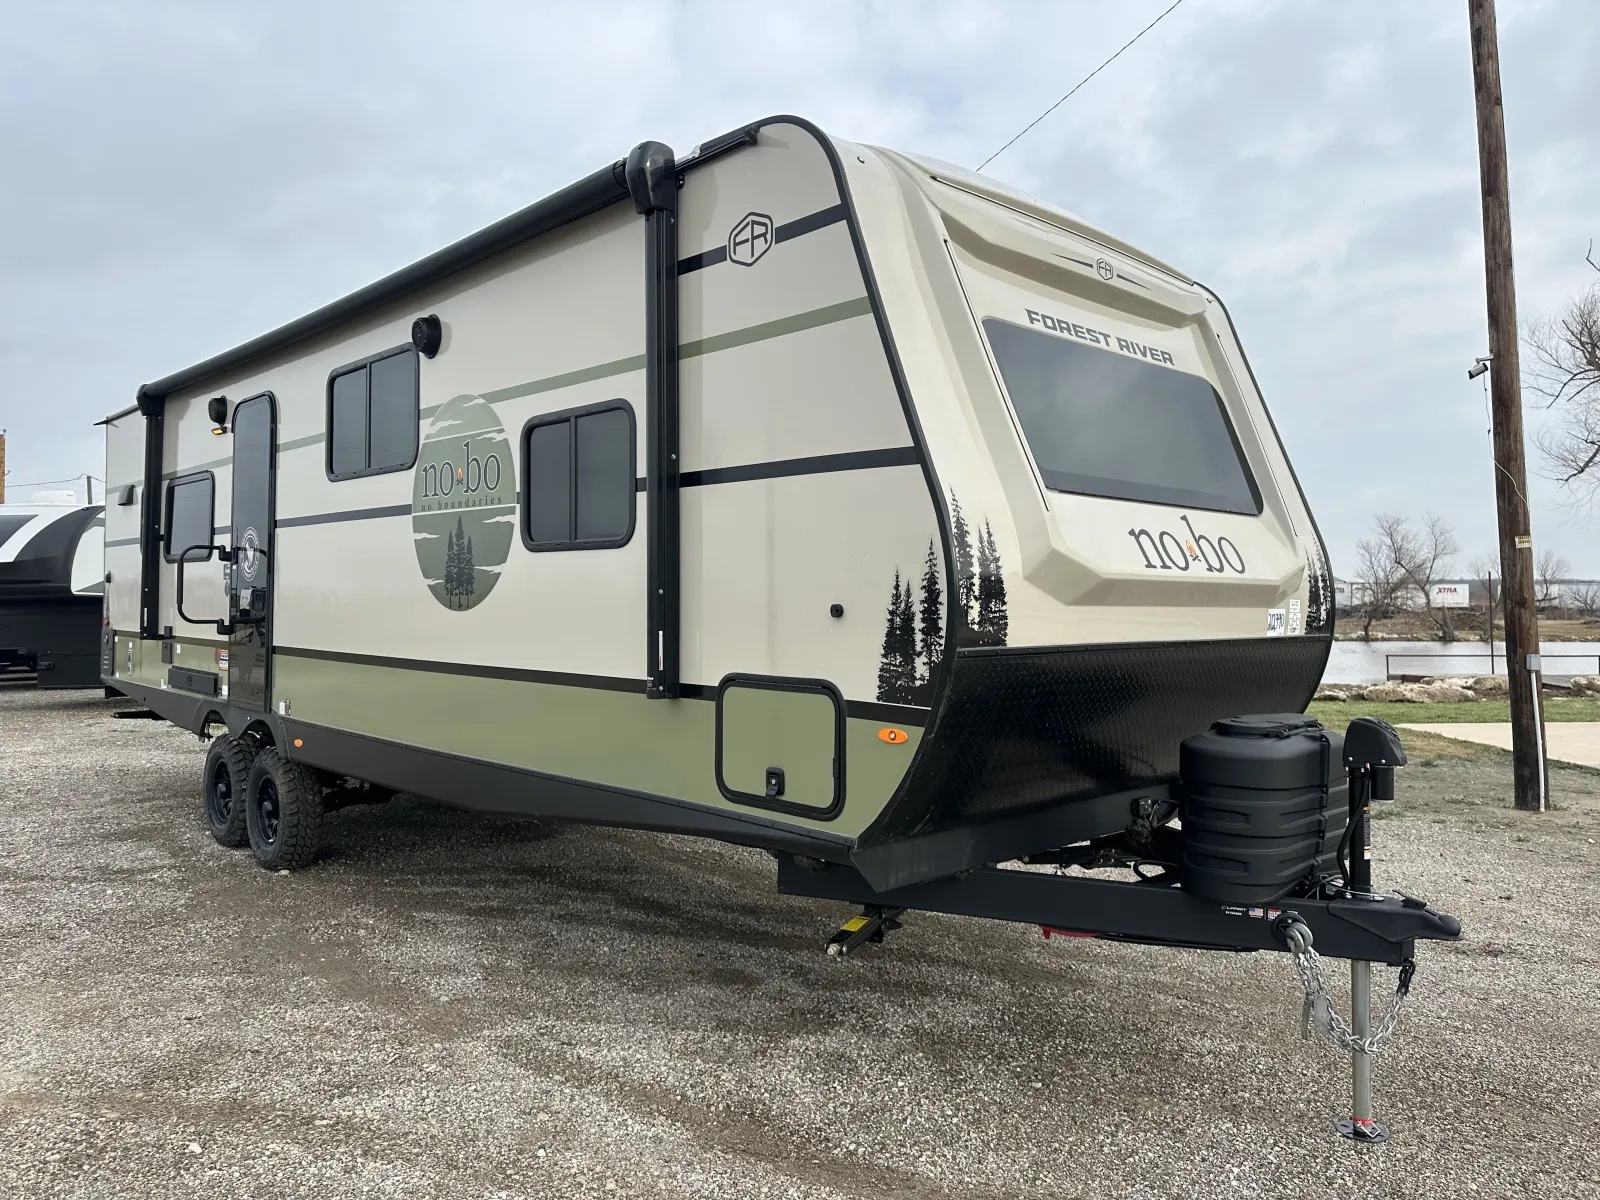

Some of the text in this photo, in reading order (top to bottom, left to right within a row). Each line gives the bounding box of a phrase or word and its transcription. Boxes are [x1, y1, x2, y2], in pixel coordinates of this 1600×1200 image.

[1024, 308, 1175, 366] FOREST RIVER
[421, 495, 502, 512] no boundaries
[1436, 587, 1457, 595] XTRA
